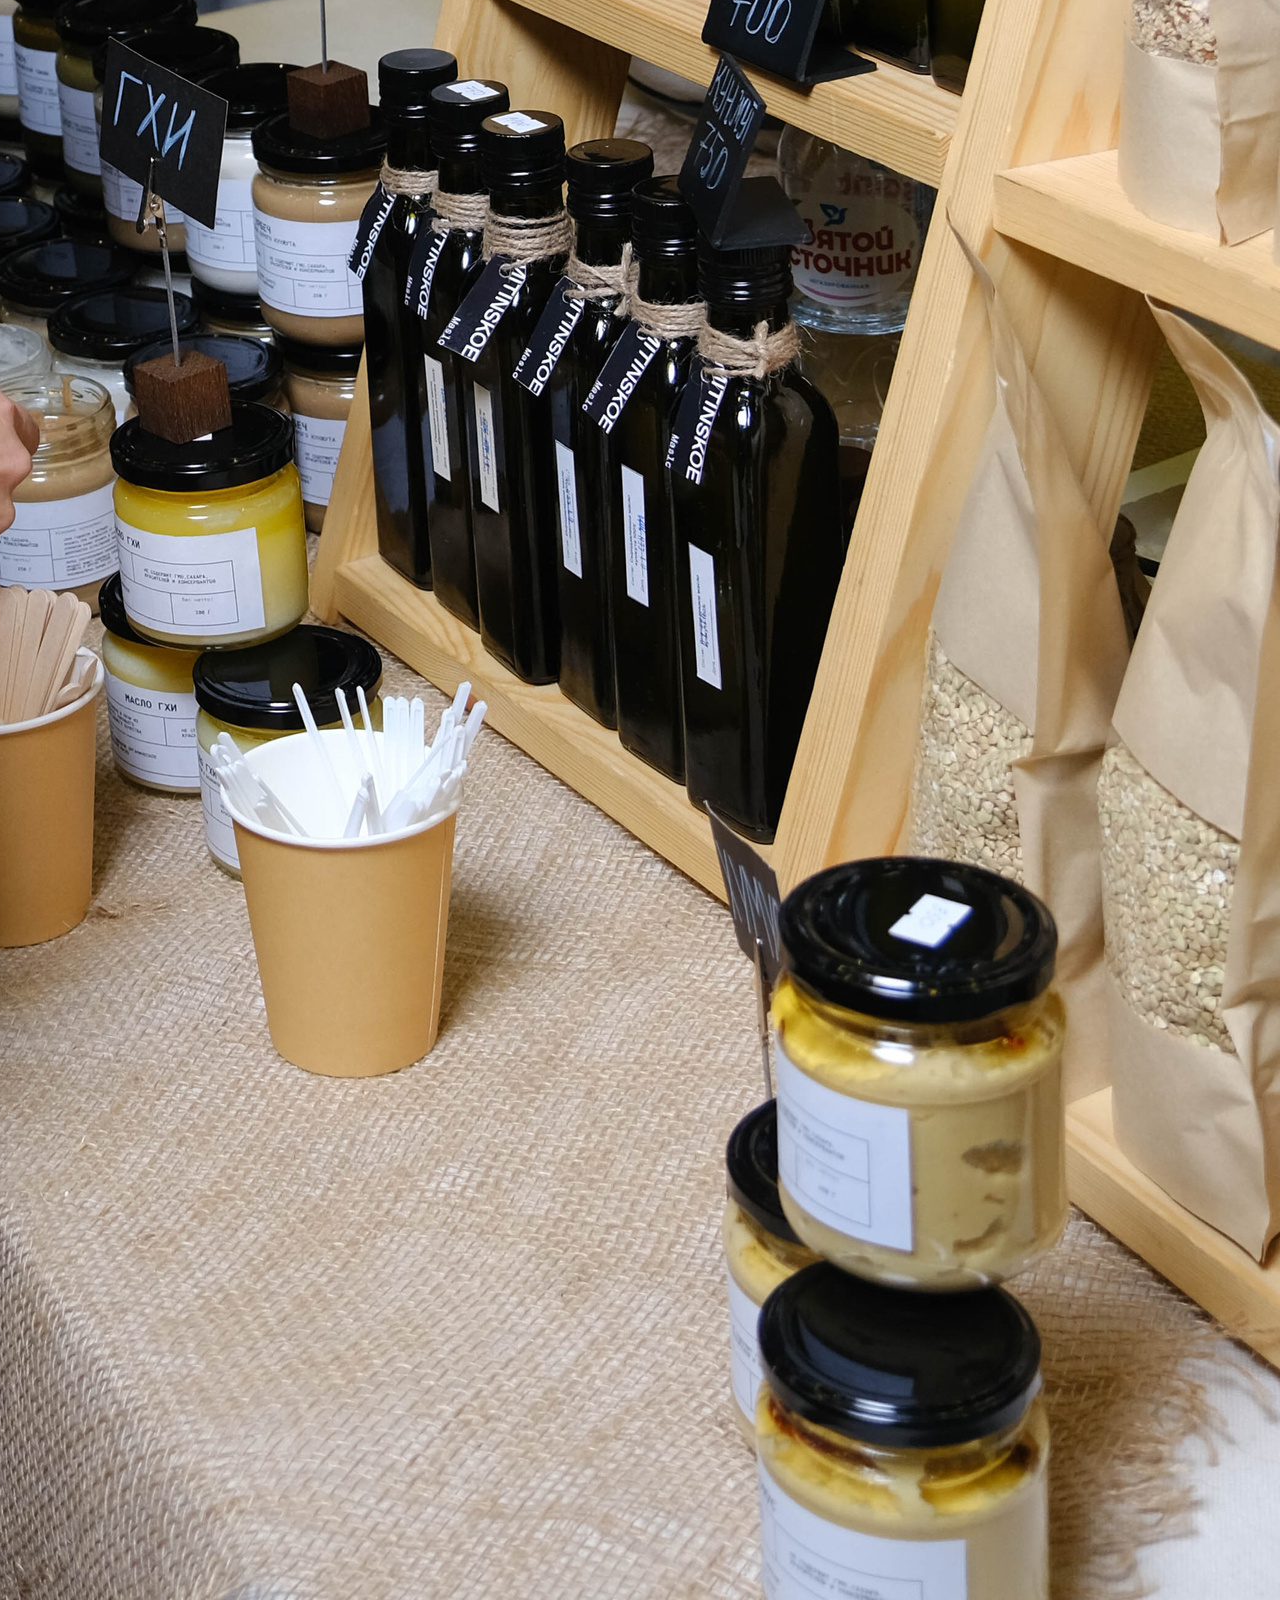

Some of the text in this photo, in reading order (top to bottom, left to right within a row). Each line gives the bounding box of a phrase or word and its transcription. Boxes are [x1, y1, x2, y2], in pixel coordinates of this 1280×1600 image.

[708, 58, 759, 145] КУНЖУТ
[113, 70, 196, 171] ГХИ
[693, 120, 728, 190] 750
[803, 218, 894, 252] ВЯТОЙ
[790, 245, 912, 278] СТОЧНИК
[437, 316, 461, 346] Maslo
[512, 347, 532, 380] Maslo
[126, 536, 141, 549] ГХИ
[124, 693, 178, 712] МАСЛО ГХИ
